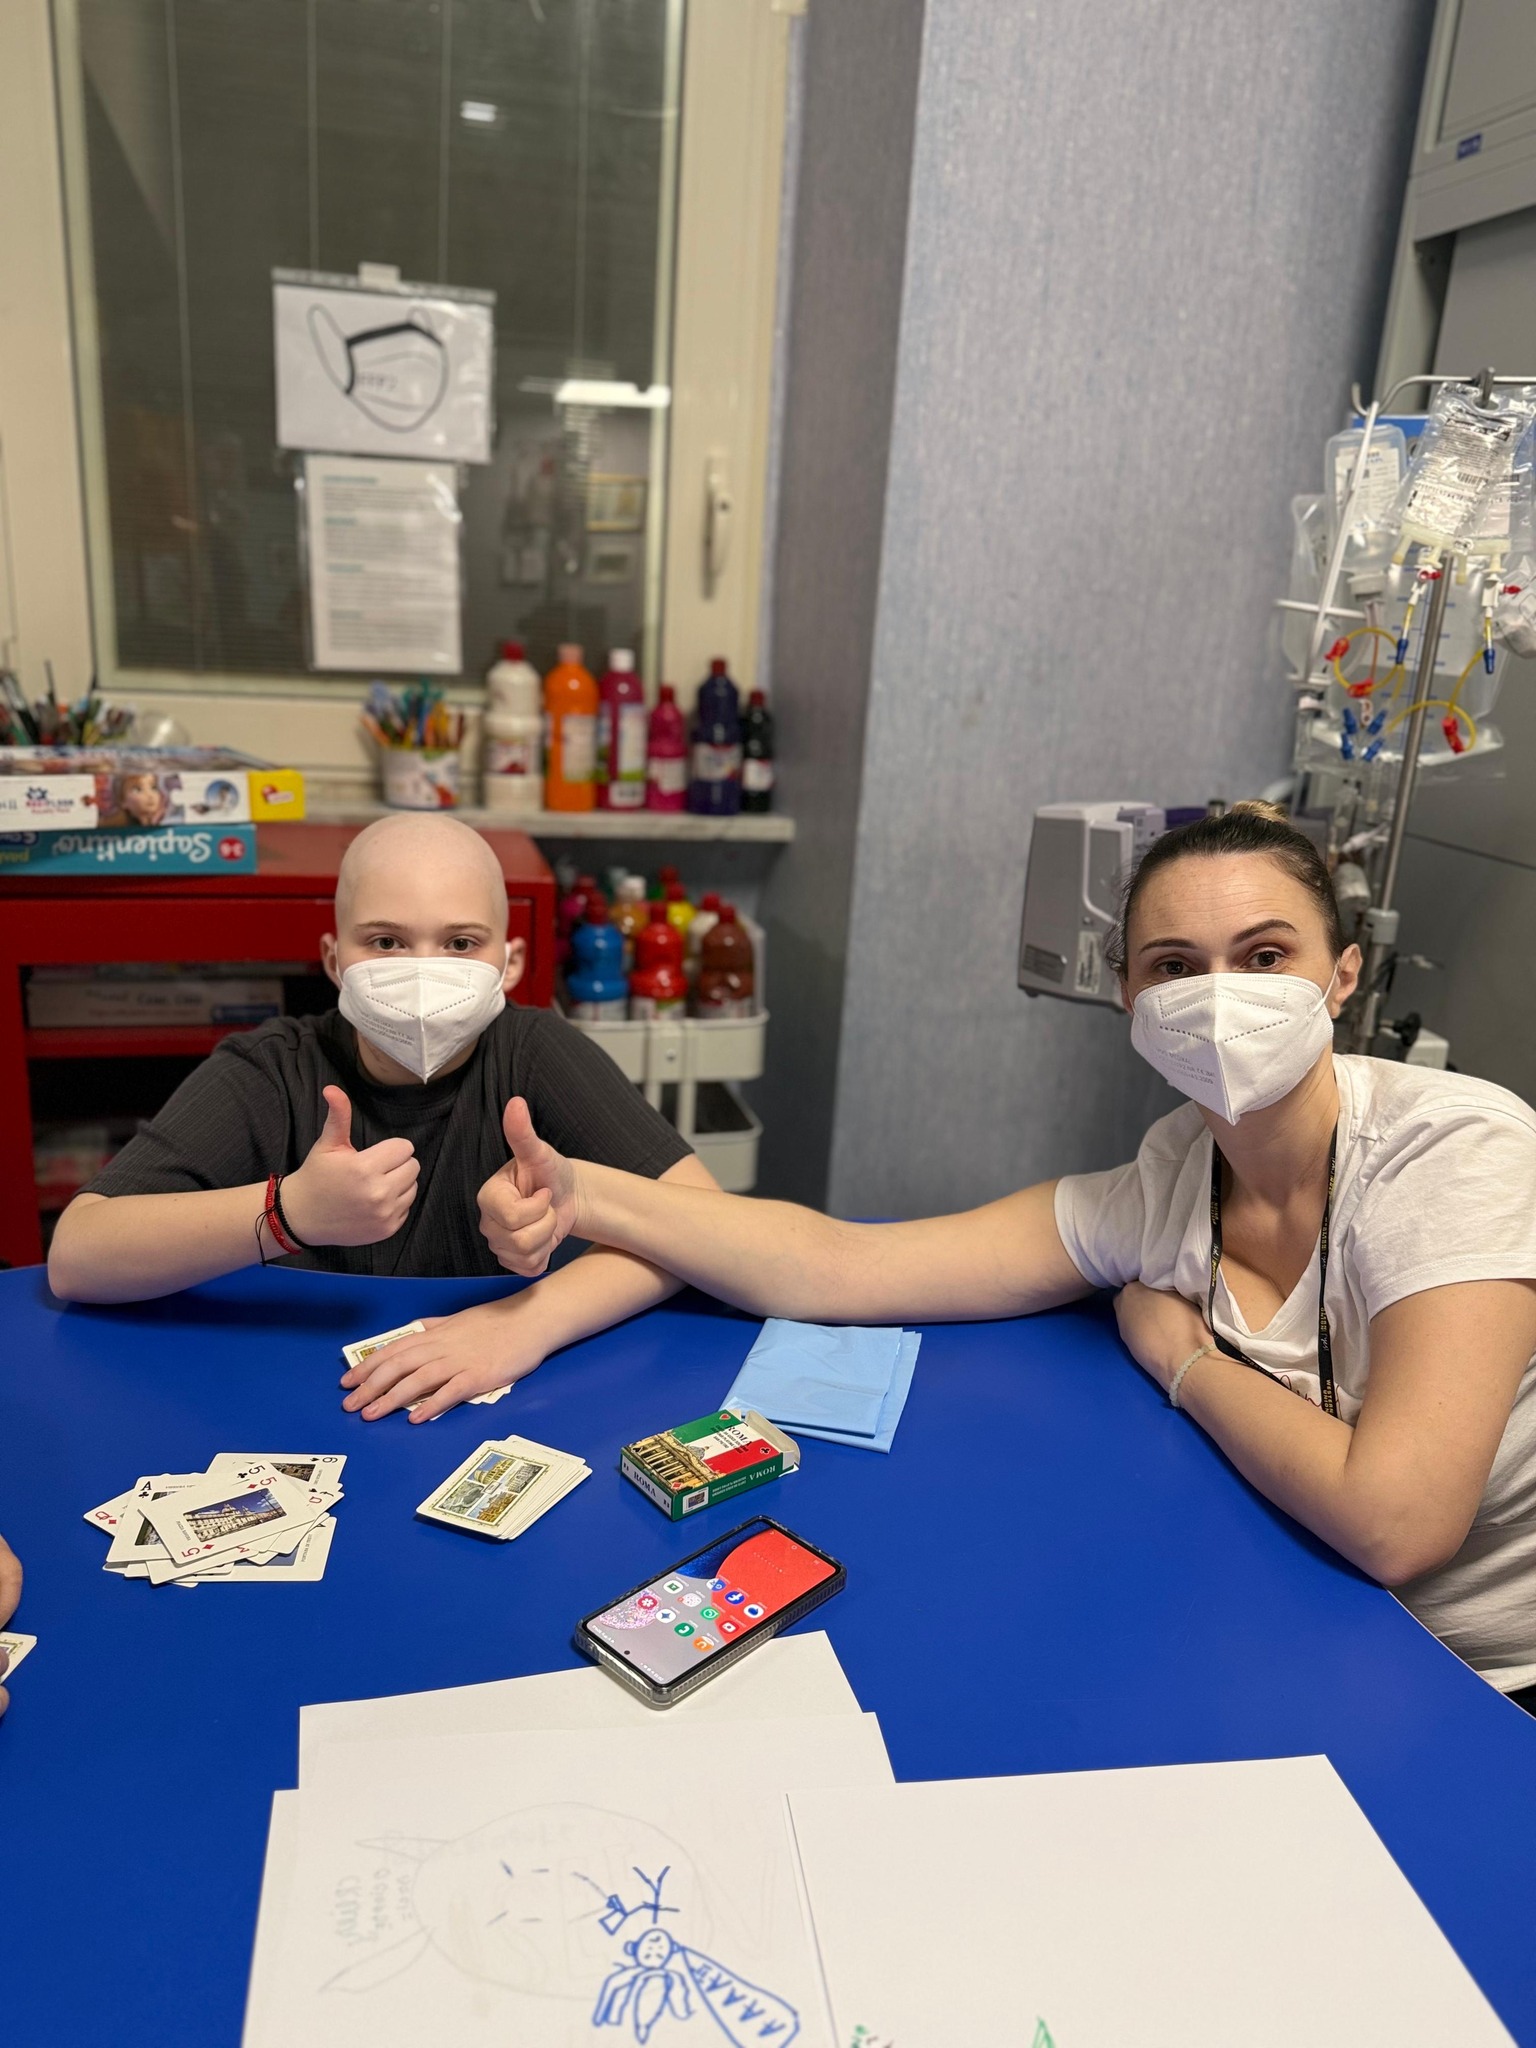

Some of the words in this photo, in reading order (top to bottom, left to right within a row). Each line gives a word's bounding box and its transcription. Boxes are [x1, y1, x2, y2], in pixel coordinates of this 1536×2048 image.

[1326, 1380, 1334, 1413] WESTERN
[725, 1424, 753, 1447] ROMA
[249, 1465, 266, 1475] 5
[749, 1465, 776, 1481] ROMA
[140, 1481, 152, 1491] A
[260, 1476, 277, 1486] 5
[633, 1472, 657, 1497] ROMA
[181, 1547, 200, 1557] 5
